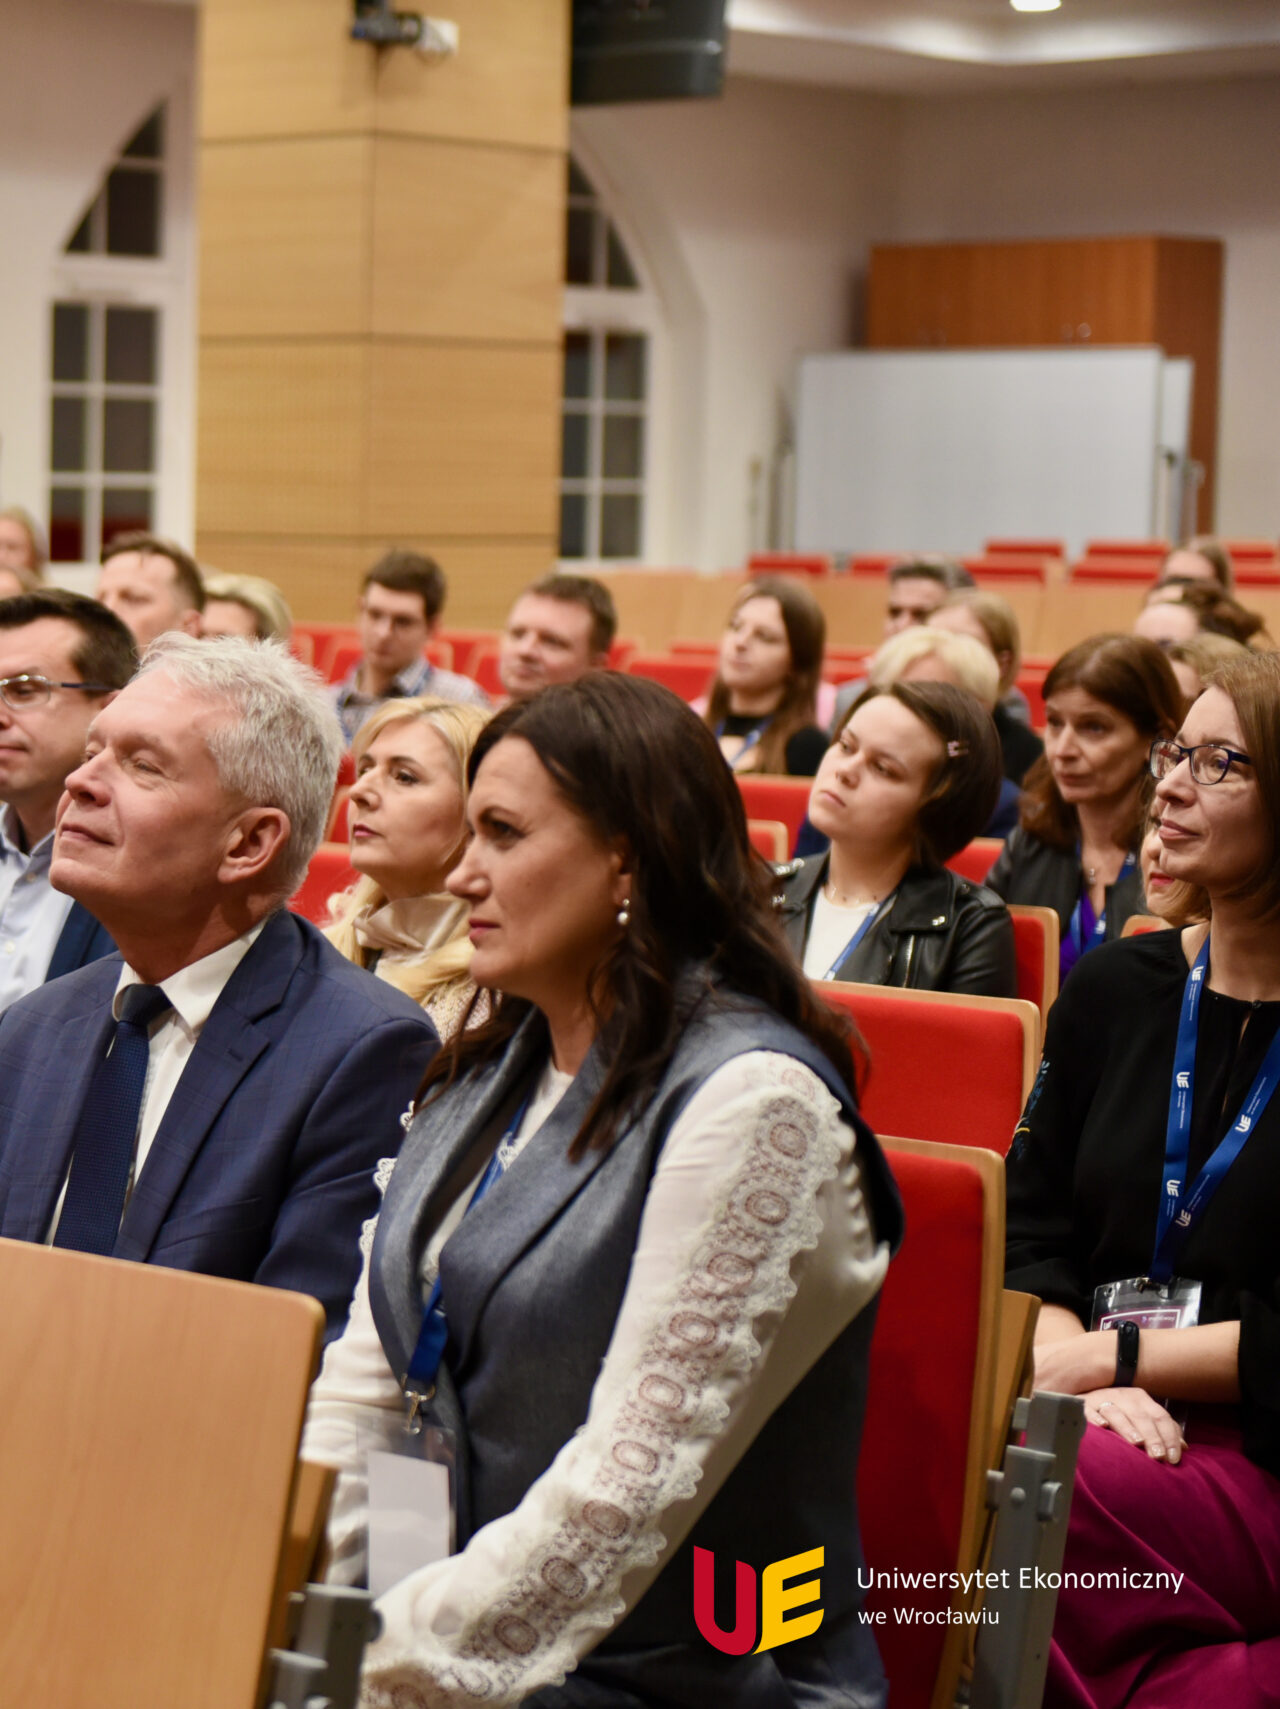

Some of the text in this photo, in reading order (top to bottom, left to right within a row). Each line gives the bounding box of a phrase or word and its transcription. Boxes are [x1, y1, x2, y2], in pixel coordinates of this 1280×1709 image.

[1176, 1072, 1190, 1088] UE
[1235, 1114, 1251, 1133] UE
[1166, 1179, 1181, 1197] UE
[1175, 1209, 1192, 1227] UE
